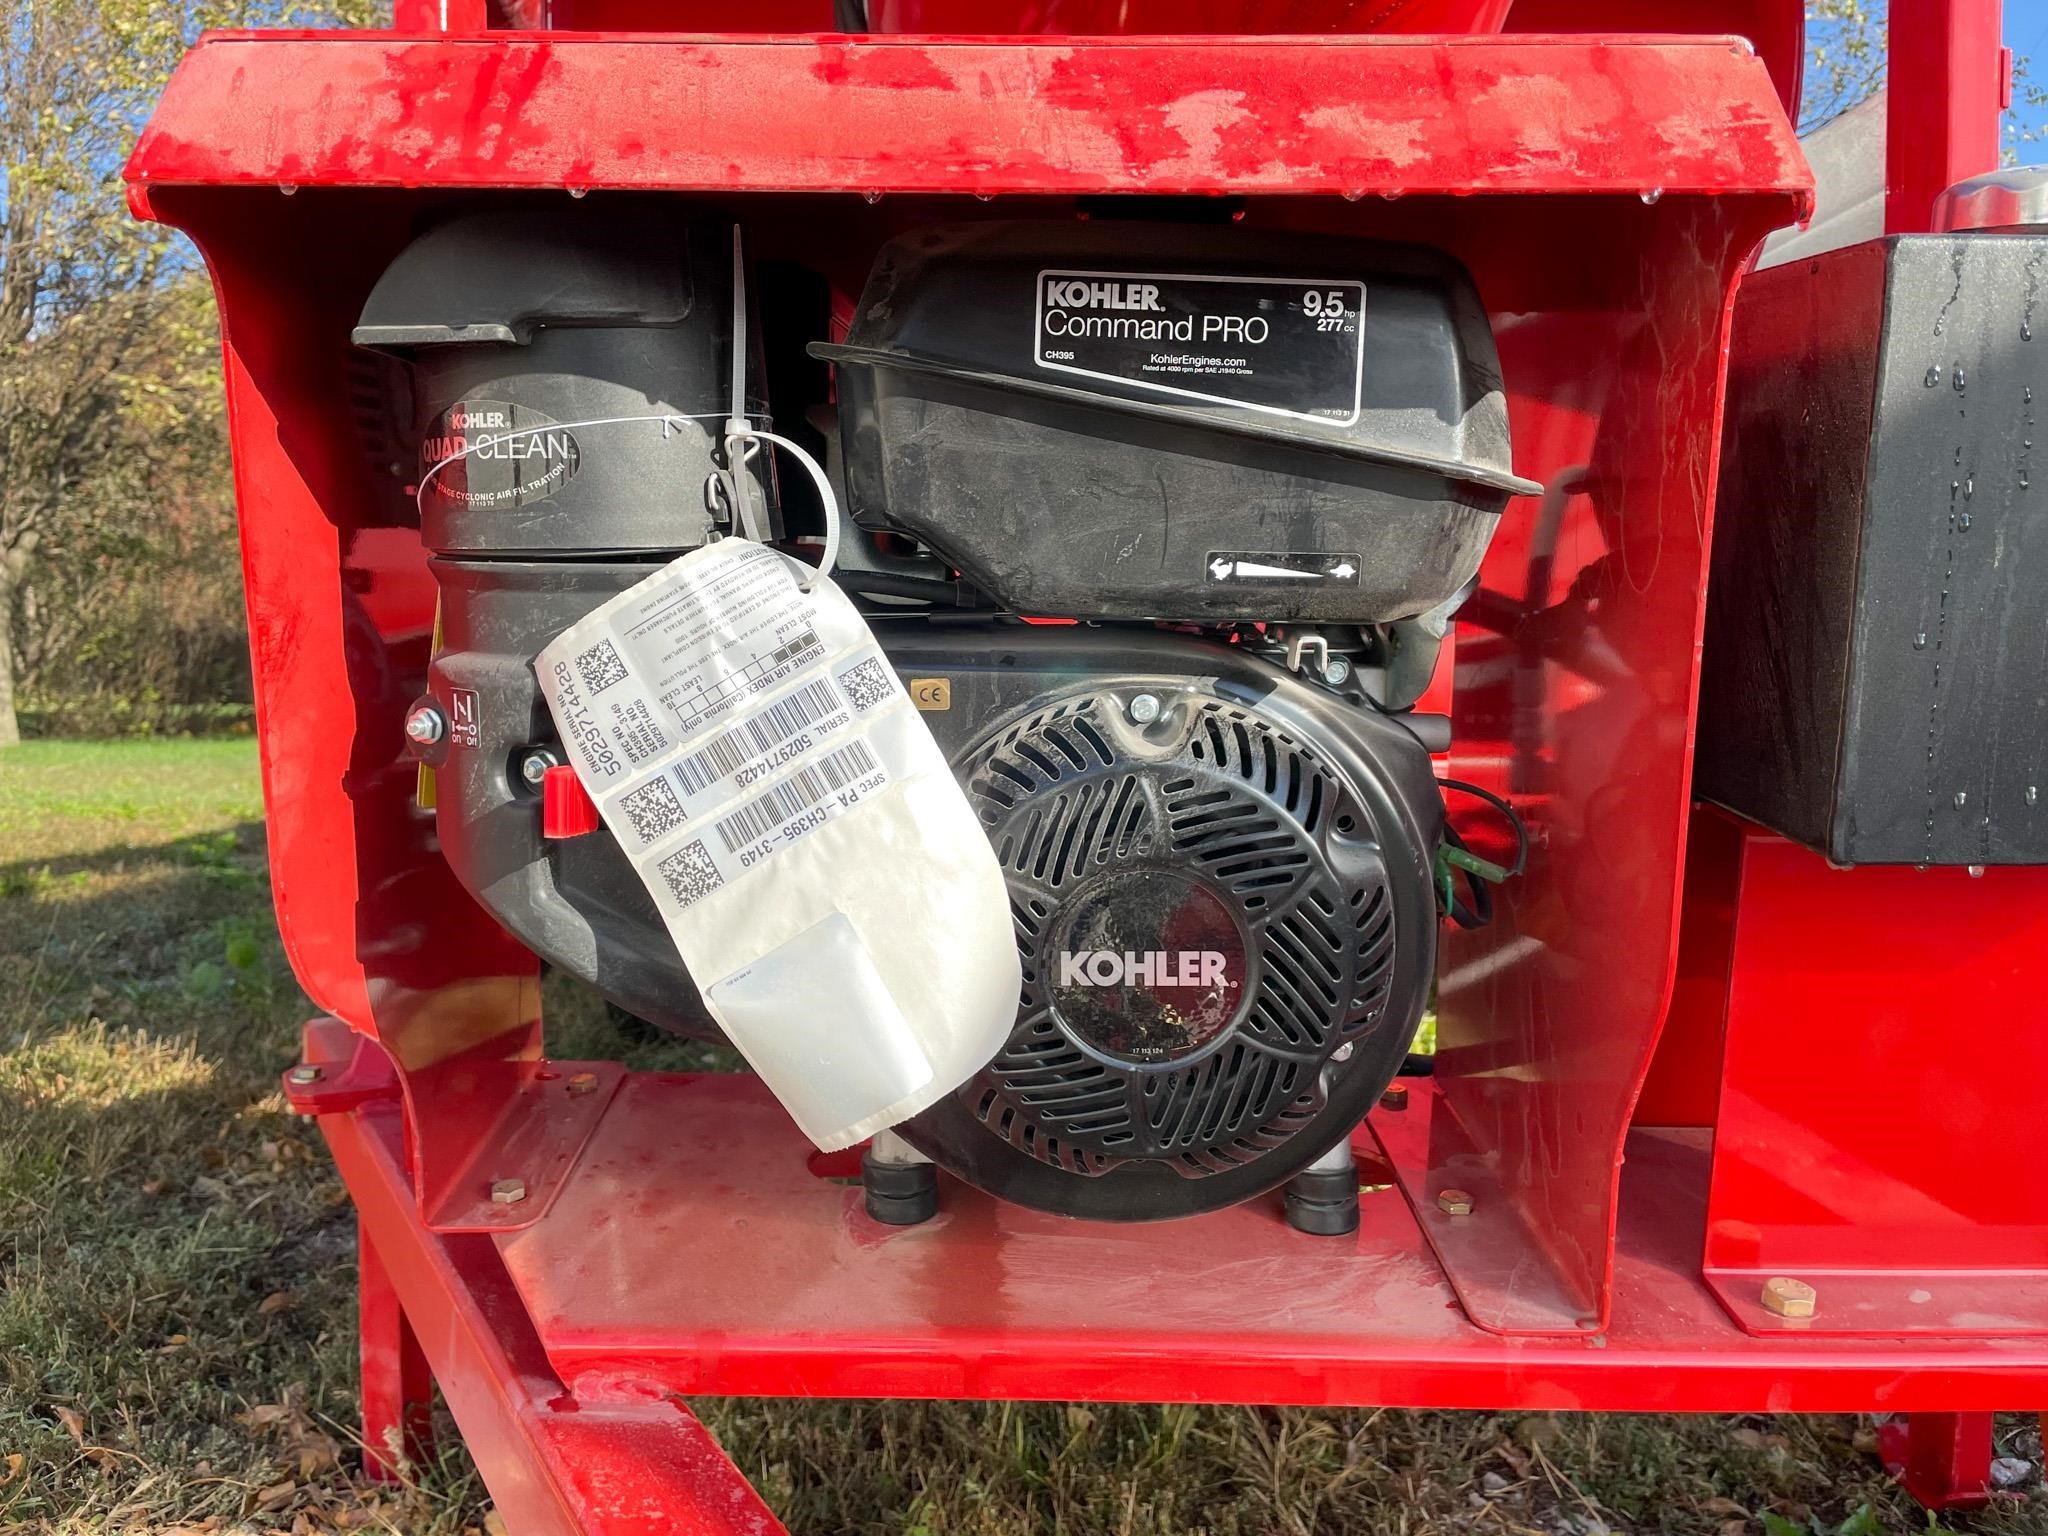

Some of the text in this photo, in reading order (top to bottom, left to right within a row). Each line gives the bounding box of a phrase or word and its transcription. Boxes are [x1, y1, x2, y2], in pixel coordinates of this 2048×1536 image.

[1303, 291, 1356, 319] 9.5 hp
[1045, 309, 1269, 344] Command PRO
[1317, 318, 1344, 332] 277
[1045, 350, 1075, 360] CH395
[1150, 353, 1247, 367] KohlerEngines.com
[455, 491, 495, 501] CYCLONIC
[496, 487, 512, 499] AIR
[774, 618, 797, 636] CLEAN
[791, 643, 825, 668] ENGINE
[773, 663, 791, 678] AIR
[658, 674, 702, 704] LEAST CLEAN
[746, 673, 774, 694] INDEX
[553, 661, 621, 776] 5029714428
[561, 707, 583, 738] SERIAL
[633, 697, 667, 748] 5029714428
[679, 714, 703, 734] only)
[634, 720, 657, 753] SERIAL
[733, 710, 848, 788] SERIAL 5029714428
[577, 739, 601, 773] ENGINE
[620, 739, 639, 764] SPEC
[858, 771, 885, 793] SPEC
